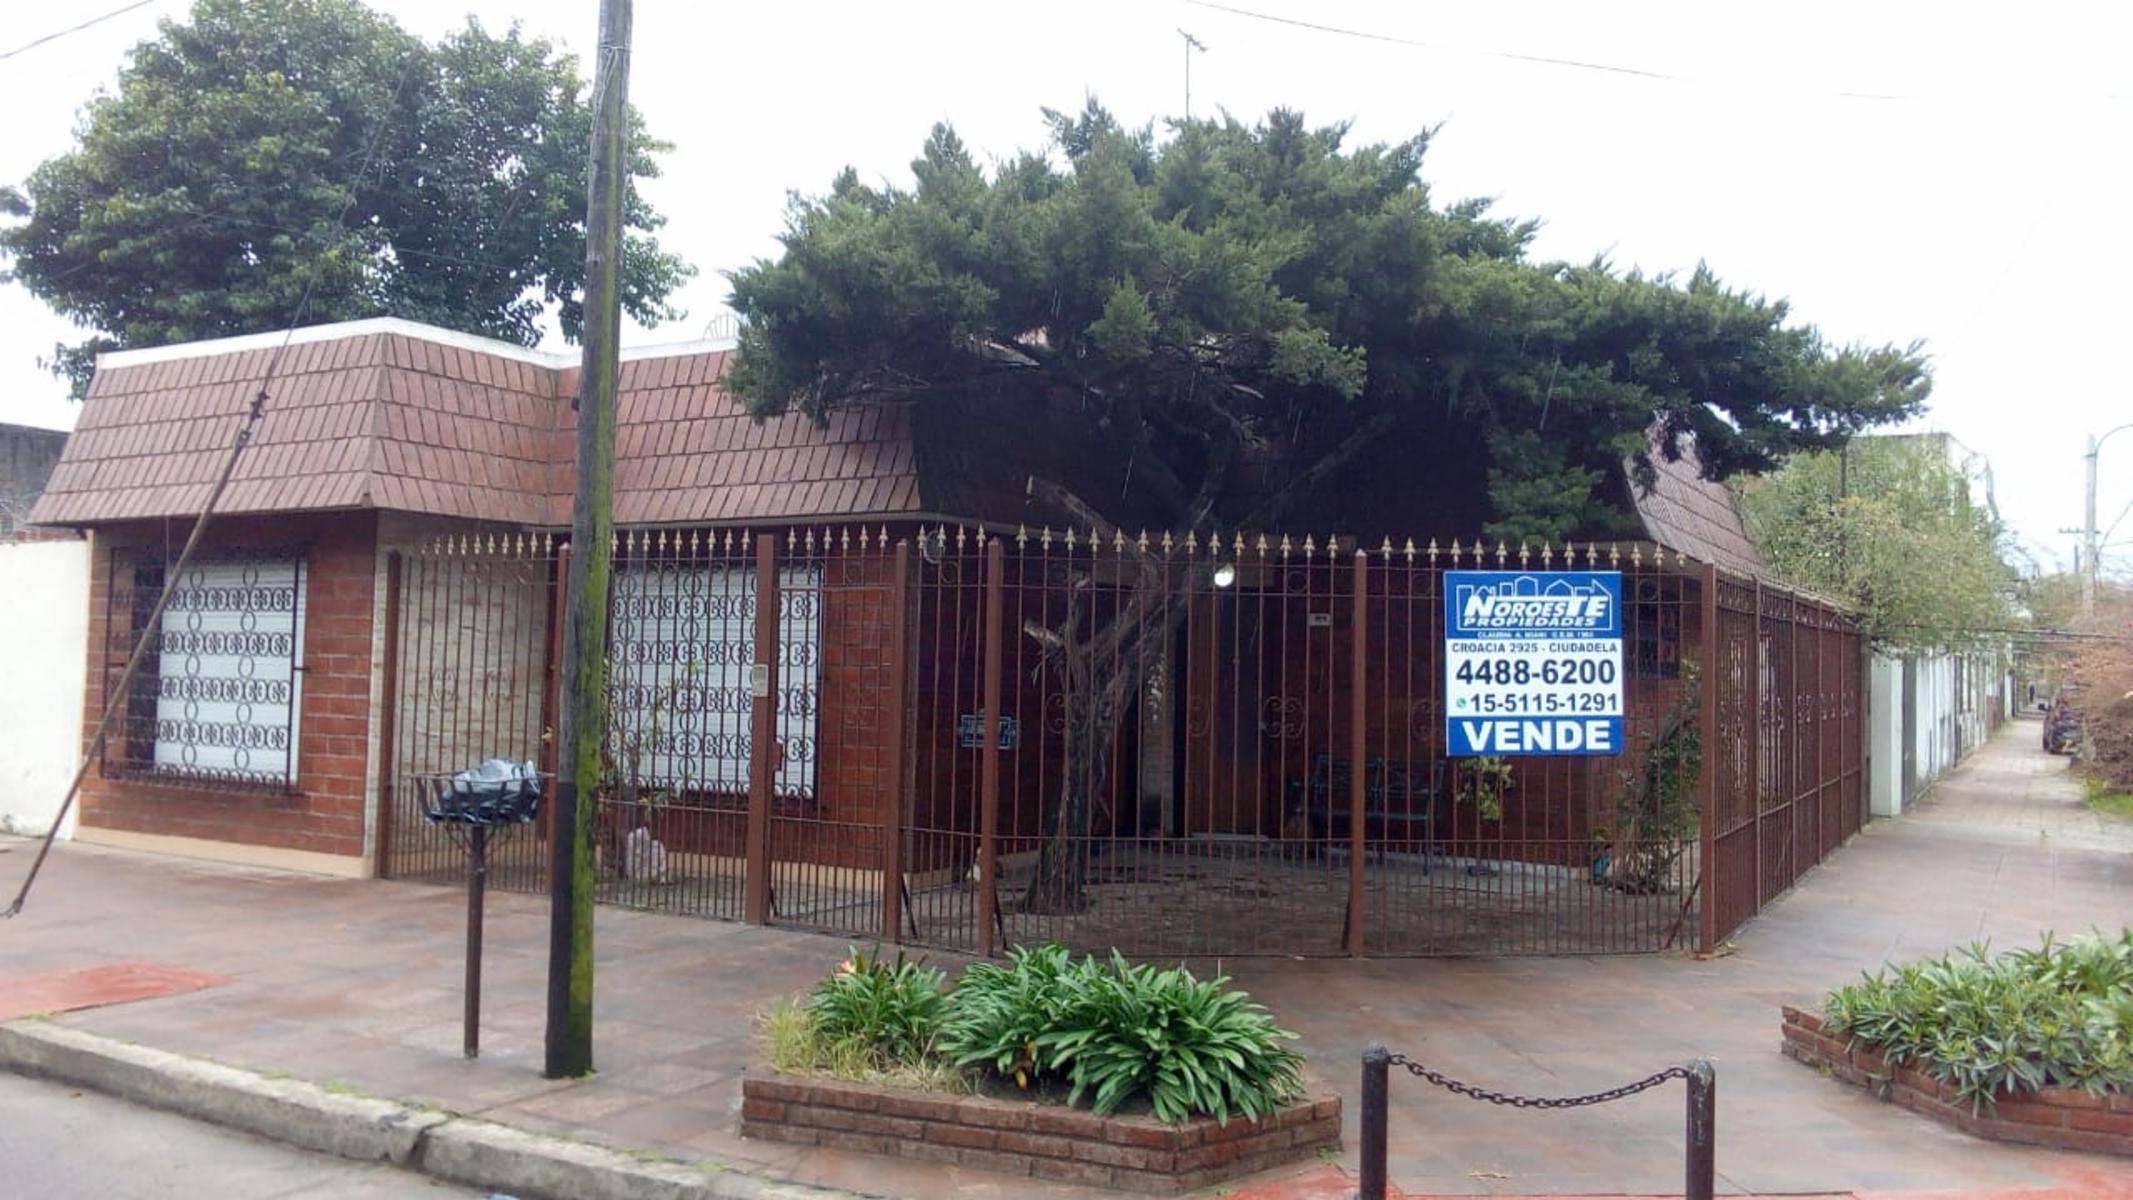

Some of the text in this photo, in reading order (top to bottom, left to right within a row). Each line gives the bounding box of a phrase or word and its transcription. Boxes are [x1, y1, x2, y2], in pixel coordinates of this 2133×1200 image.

[1464, 595, 1608, 617] NOROESTE
[1463, 617, 1597, 627] PROPIEDADES
[1452, 642, 1505, 653] CROACIA
[1510, 642, 1538, 653] 2925
[1549, 642, 1617, 653] CIUDADELA
[1456, 659, 1616, 685] 4488-6200
[1470, 693, 1617, 712] 15-5115-1291
[1462, 720, 1611, 751] VENDE
